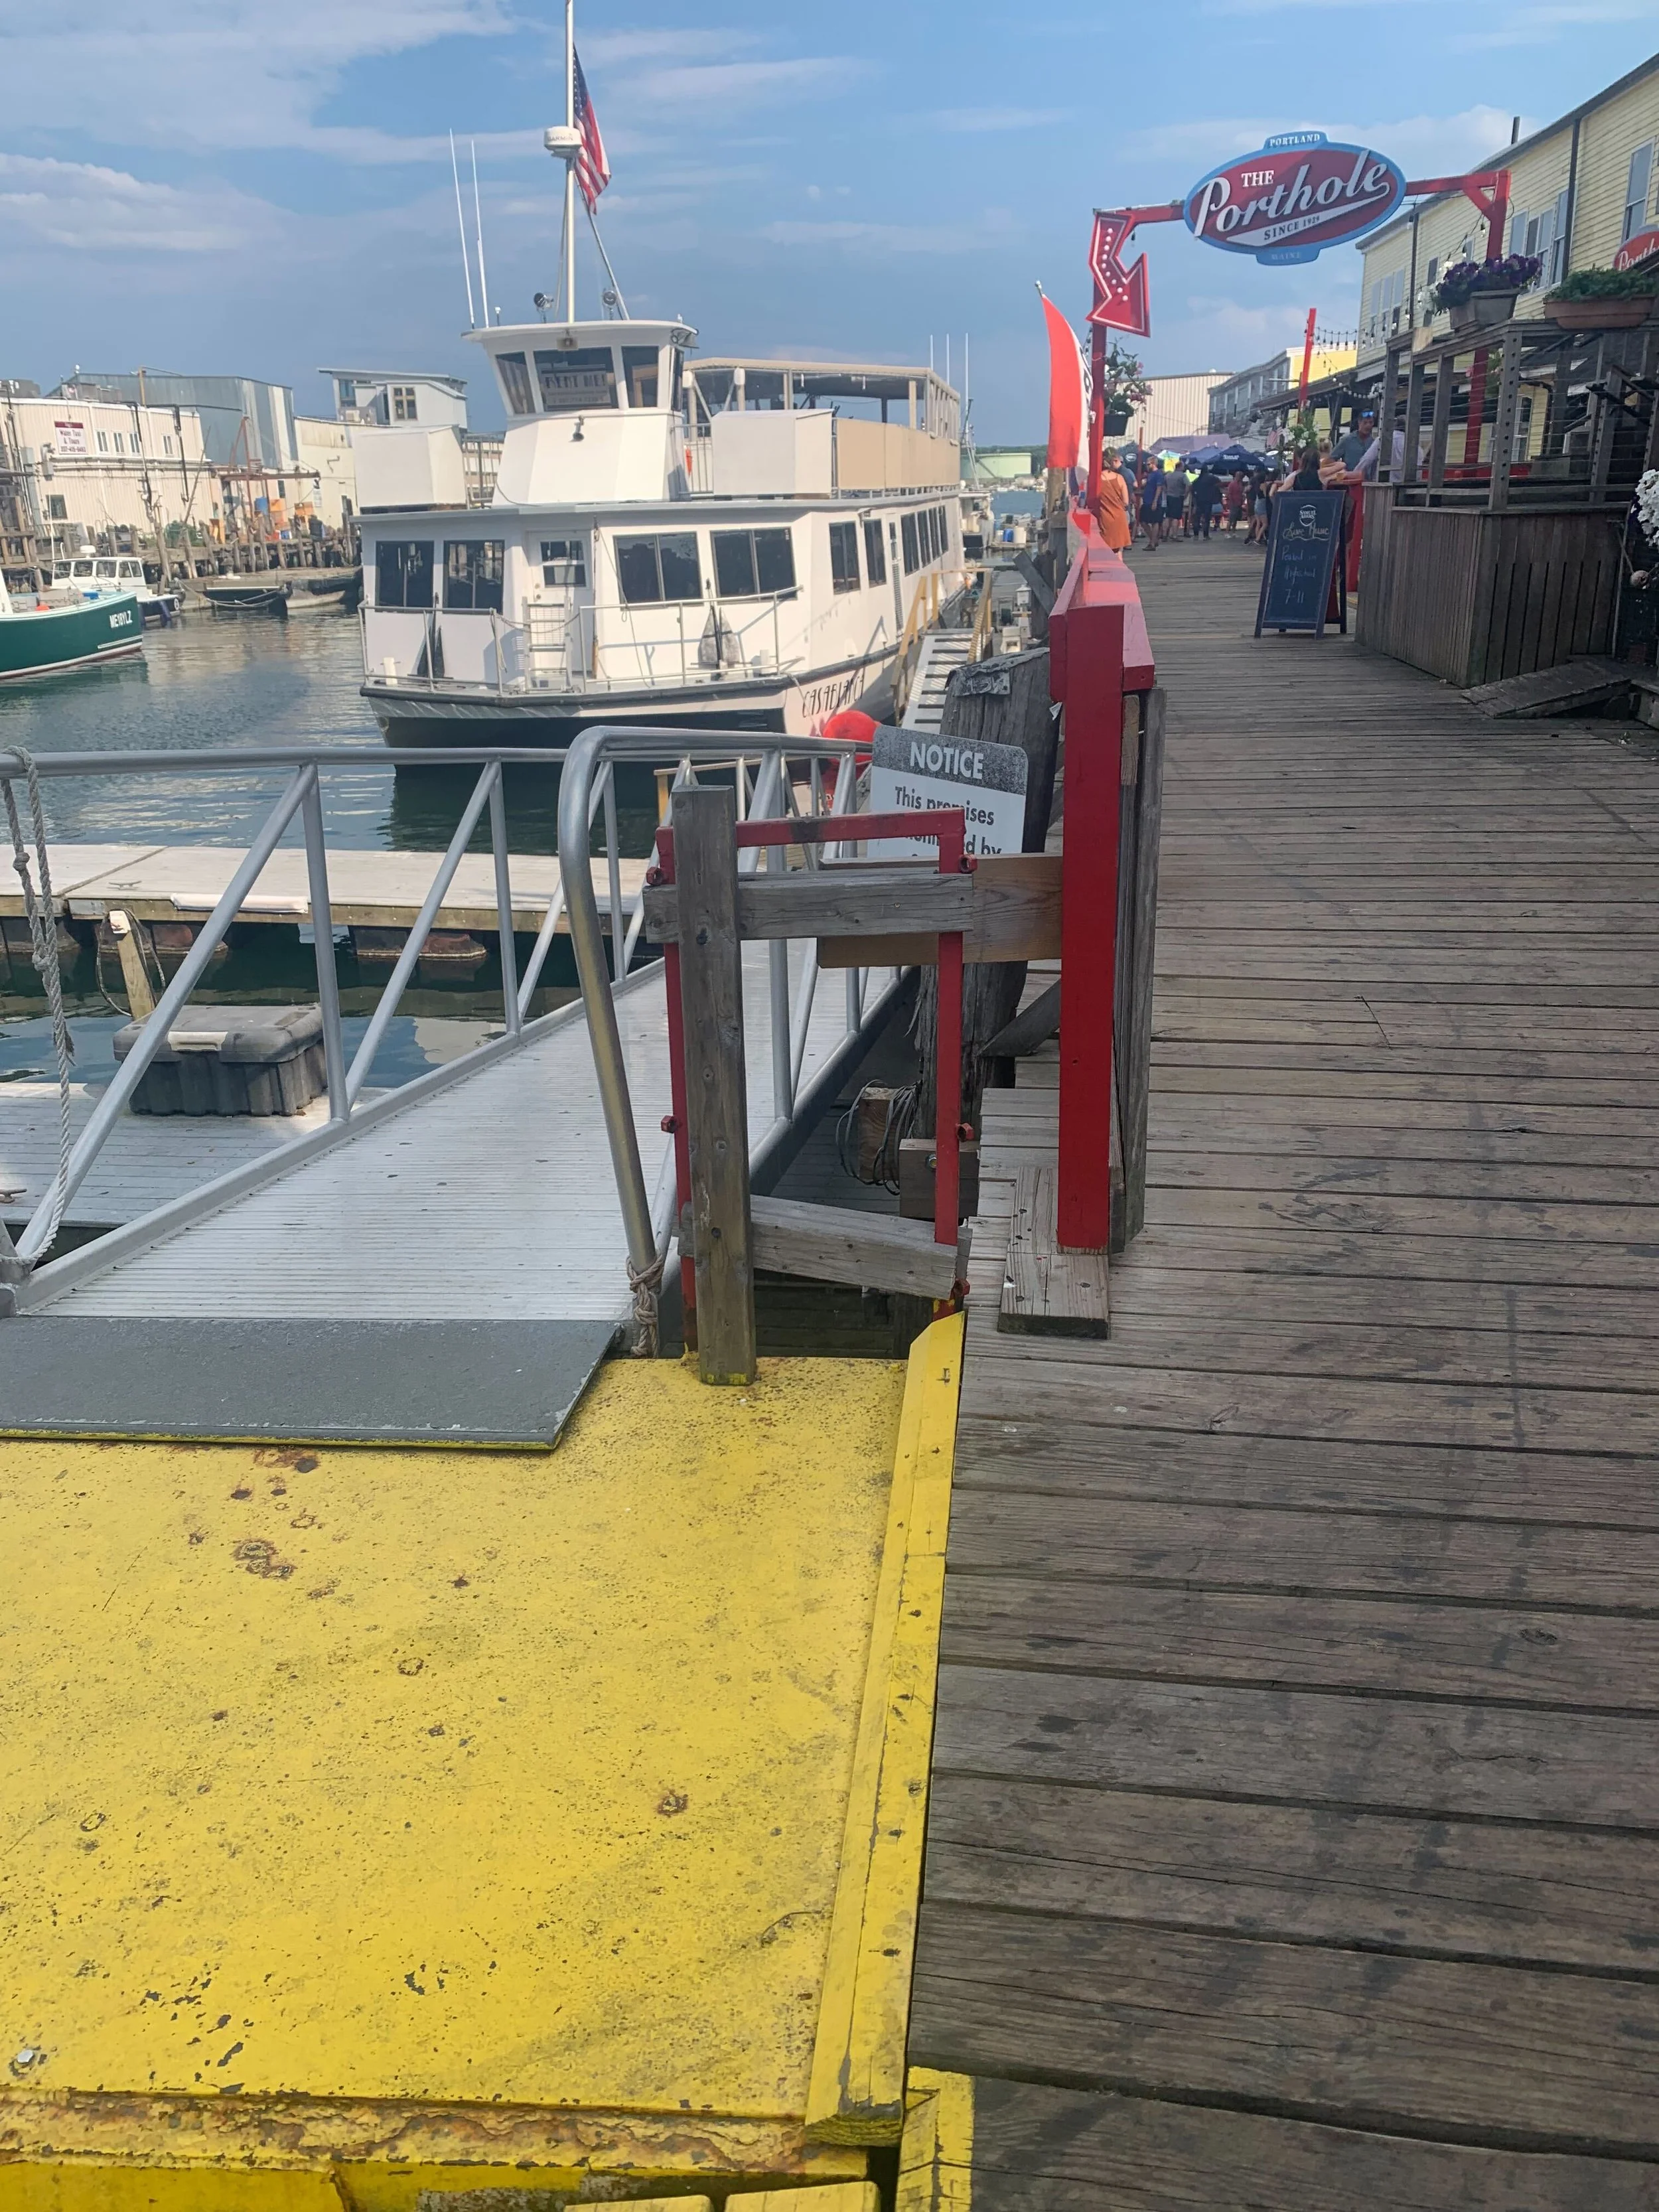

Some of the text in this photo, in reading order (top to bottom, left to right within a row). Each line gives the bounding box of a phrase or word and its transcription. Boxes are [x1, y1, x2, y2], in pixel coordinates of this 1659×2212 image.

[1269, 133, 1321, 147] PORTLAND
[1242, 170, 1275, 188] THE
[1194, 149, 1391, 240] Porthole
[1264, 221, 1299, 240] SINCE
[1618, 238, 1659, 271] Porth
[545, 376, 579, 388] RENT
[910, 742, 984, 780] NOTICE
[895, 786, 994, 826] This prises
